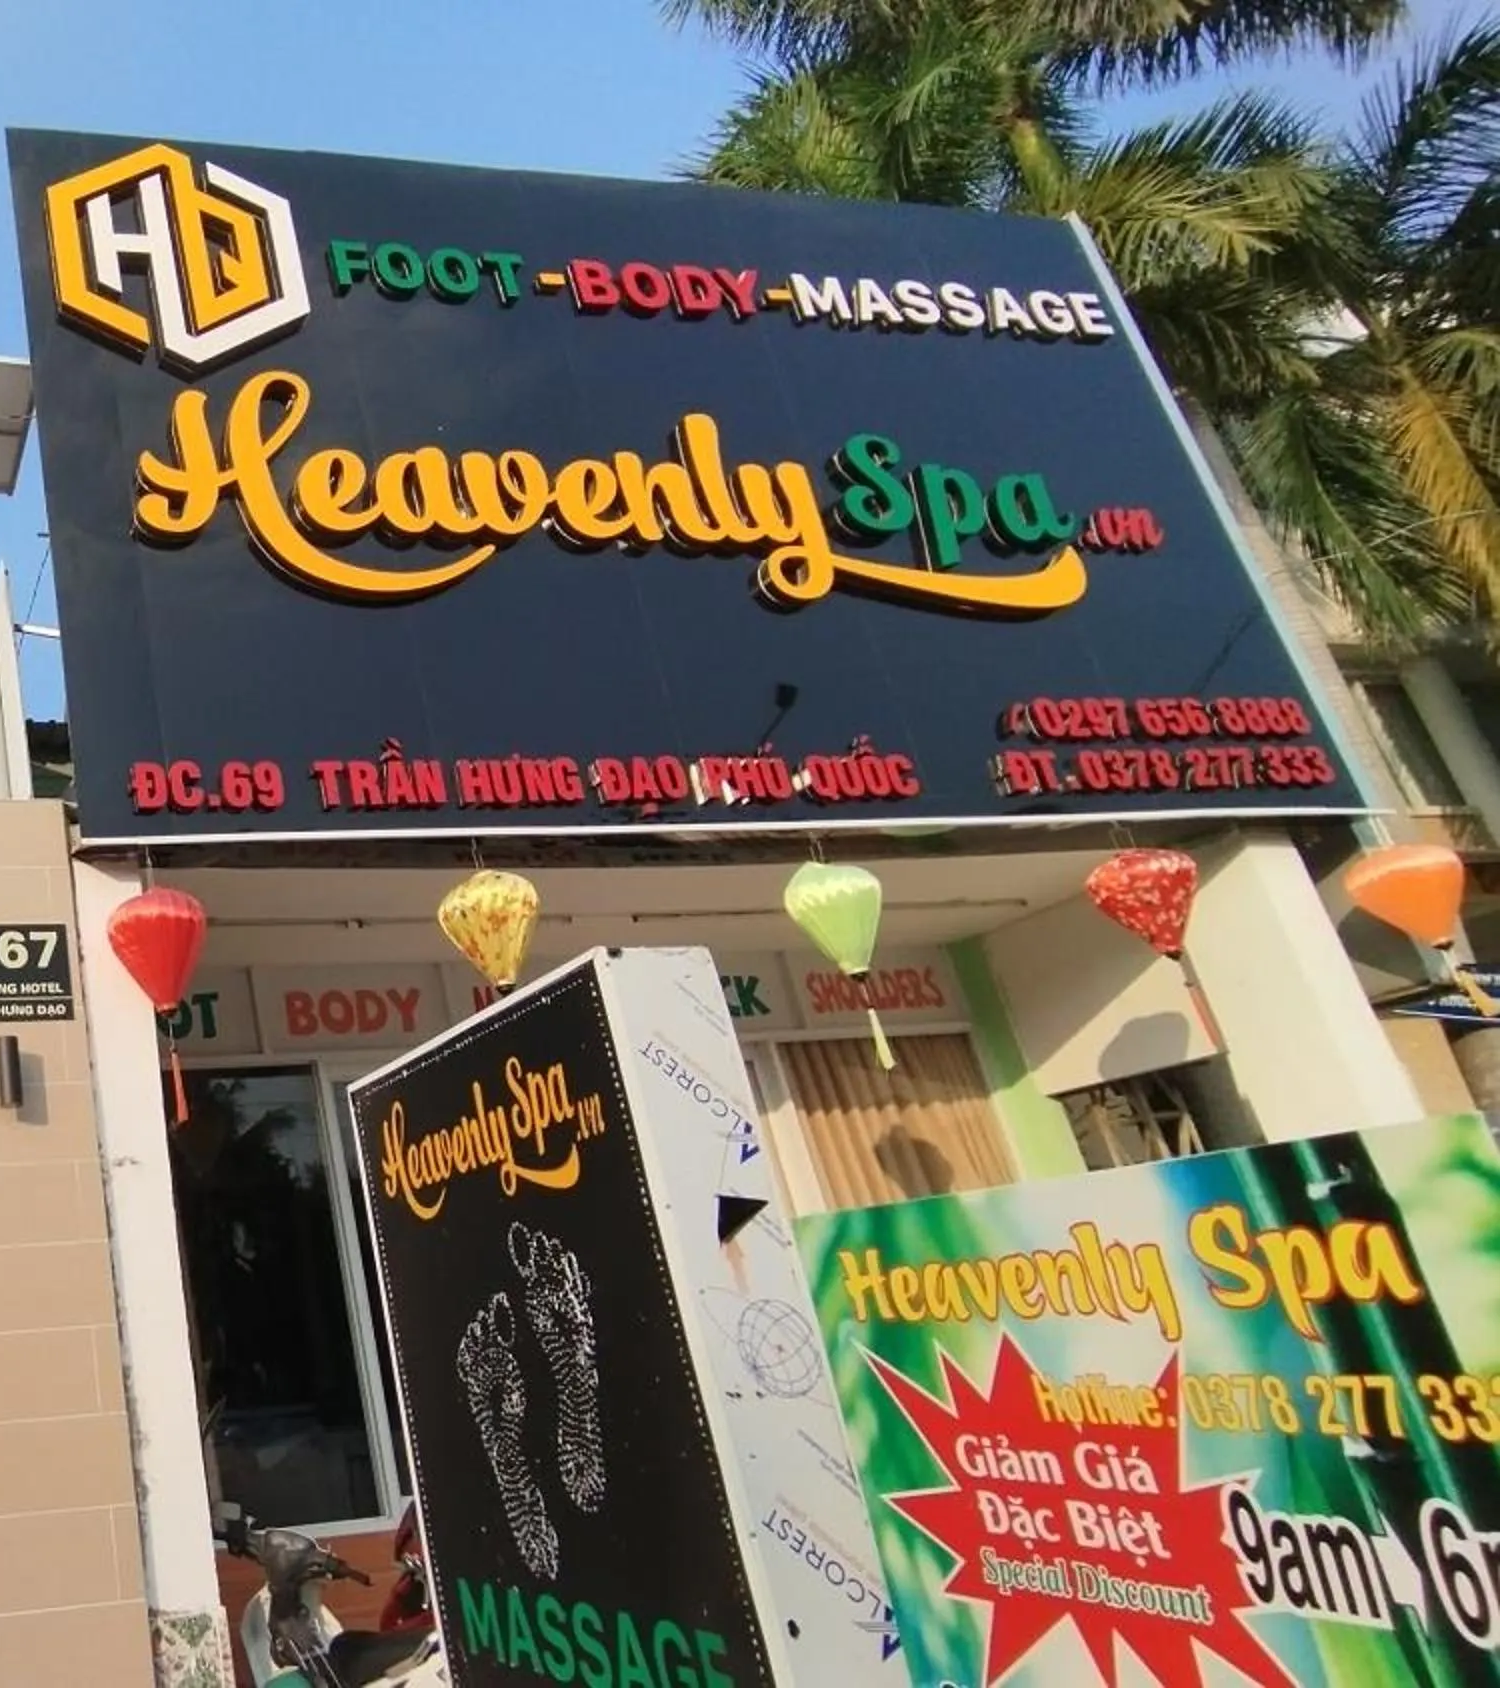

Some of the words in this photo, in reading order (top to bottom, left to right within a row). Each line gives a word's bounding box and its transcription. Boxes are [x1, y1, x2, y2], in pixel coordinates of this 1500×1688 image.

[326, 240, 524, 305] FOOT
[133, 370, 1088, 610] Heavenly
[1134, 696, 1213, 738] 656
[1215, 695, 1313, 736] 8888
[310, 737, 448, 809] TRẦN
[455, 753, 587, 806] HƯNG
[590, 754, 690, 816] ĐẠO
[692, 741, 793, 806] PHÚ
[797, 733, 920, 800] QUỐC
[1184, 748, 1256, 789] 277
[1258, 745, 1337, 786] 333
[21, 982, 65, 994] HOTEL
[284, 987, 421, 1036] BODY
[806, 966, 945, 1014] SHOULDERS
[382, 1081, 581, 1220] Heavenly
[838, 1222, 1182, 1342] Heavenly
[1188, 1203, 1422, 1343] Spa
[1031, 1373, 1178, 1432] Hotline:
[1182, 1374, 1300, 1434] 0378
[1304, 1374, 1405, 1438] 277
[955, 1434, 1065, 1485] Giảm
[1073, 1441, 1160, 1494] Giá
[976, 1489, 1061, 1549] Đặc
[1064, 1499, 1172, 1567] Biệt
[1226, 1487, 1386, 1622] 9am
[980, 1546, 1073, 1597] Special
[1072, 1559, 1215, 1626] Discount
